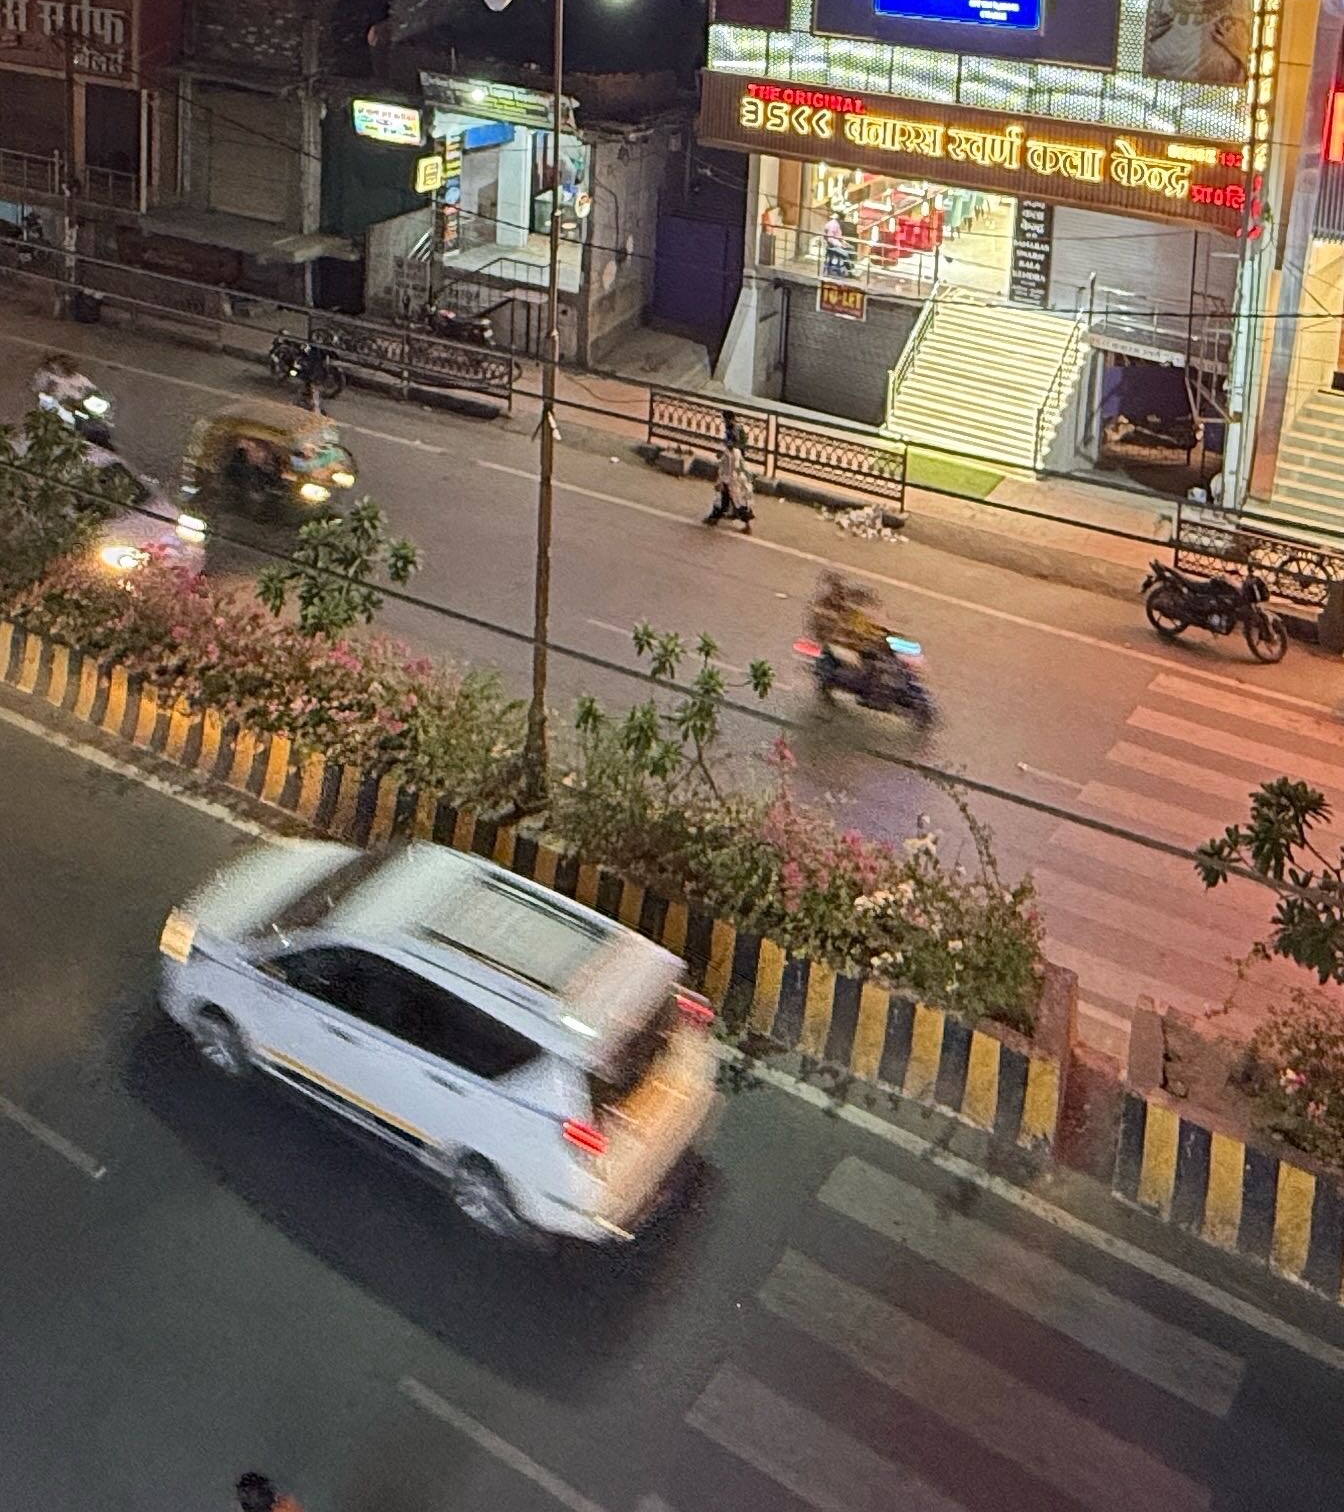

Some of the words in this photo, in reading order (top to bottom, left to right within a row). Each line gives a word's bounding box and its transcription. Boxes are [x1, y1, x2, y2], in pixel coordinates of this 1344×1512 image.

[747, 83, 780, 101] THE
[782, 89, 867, 114] ORIGINAL
[1026, 139, 1106, 183] कला
